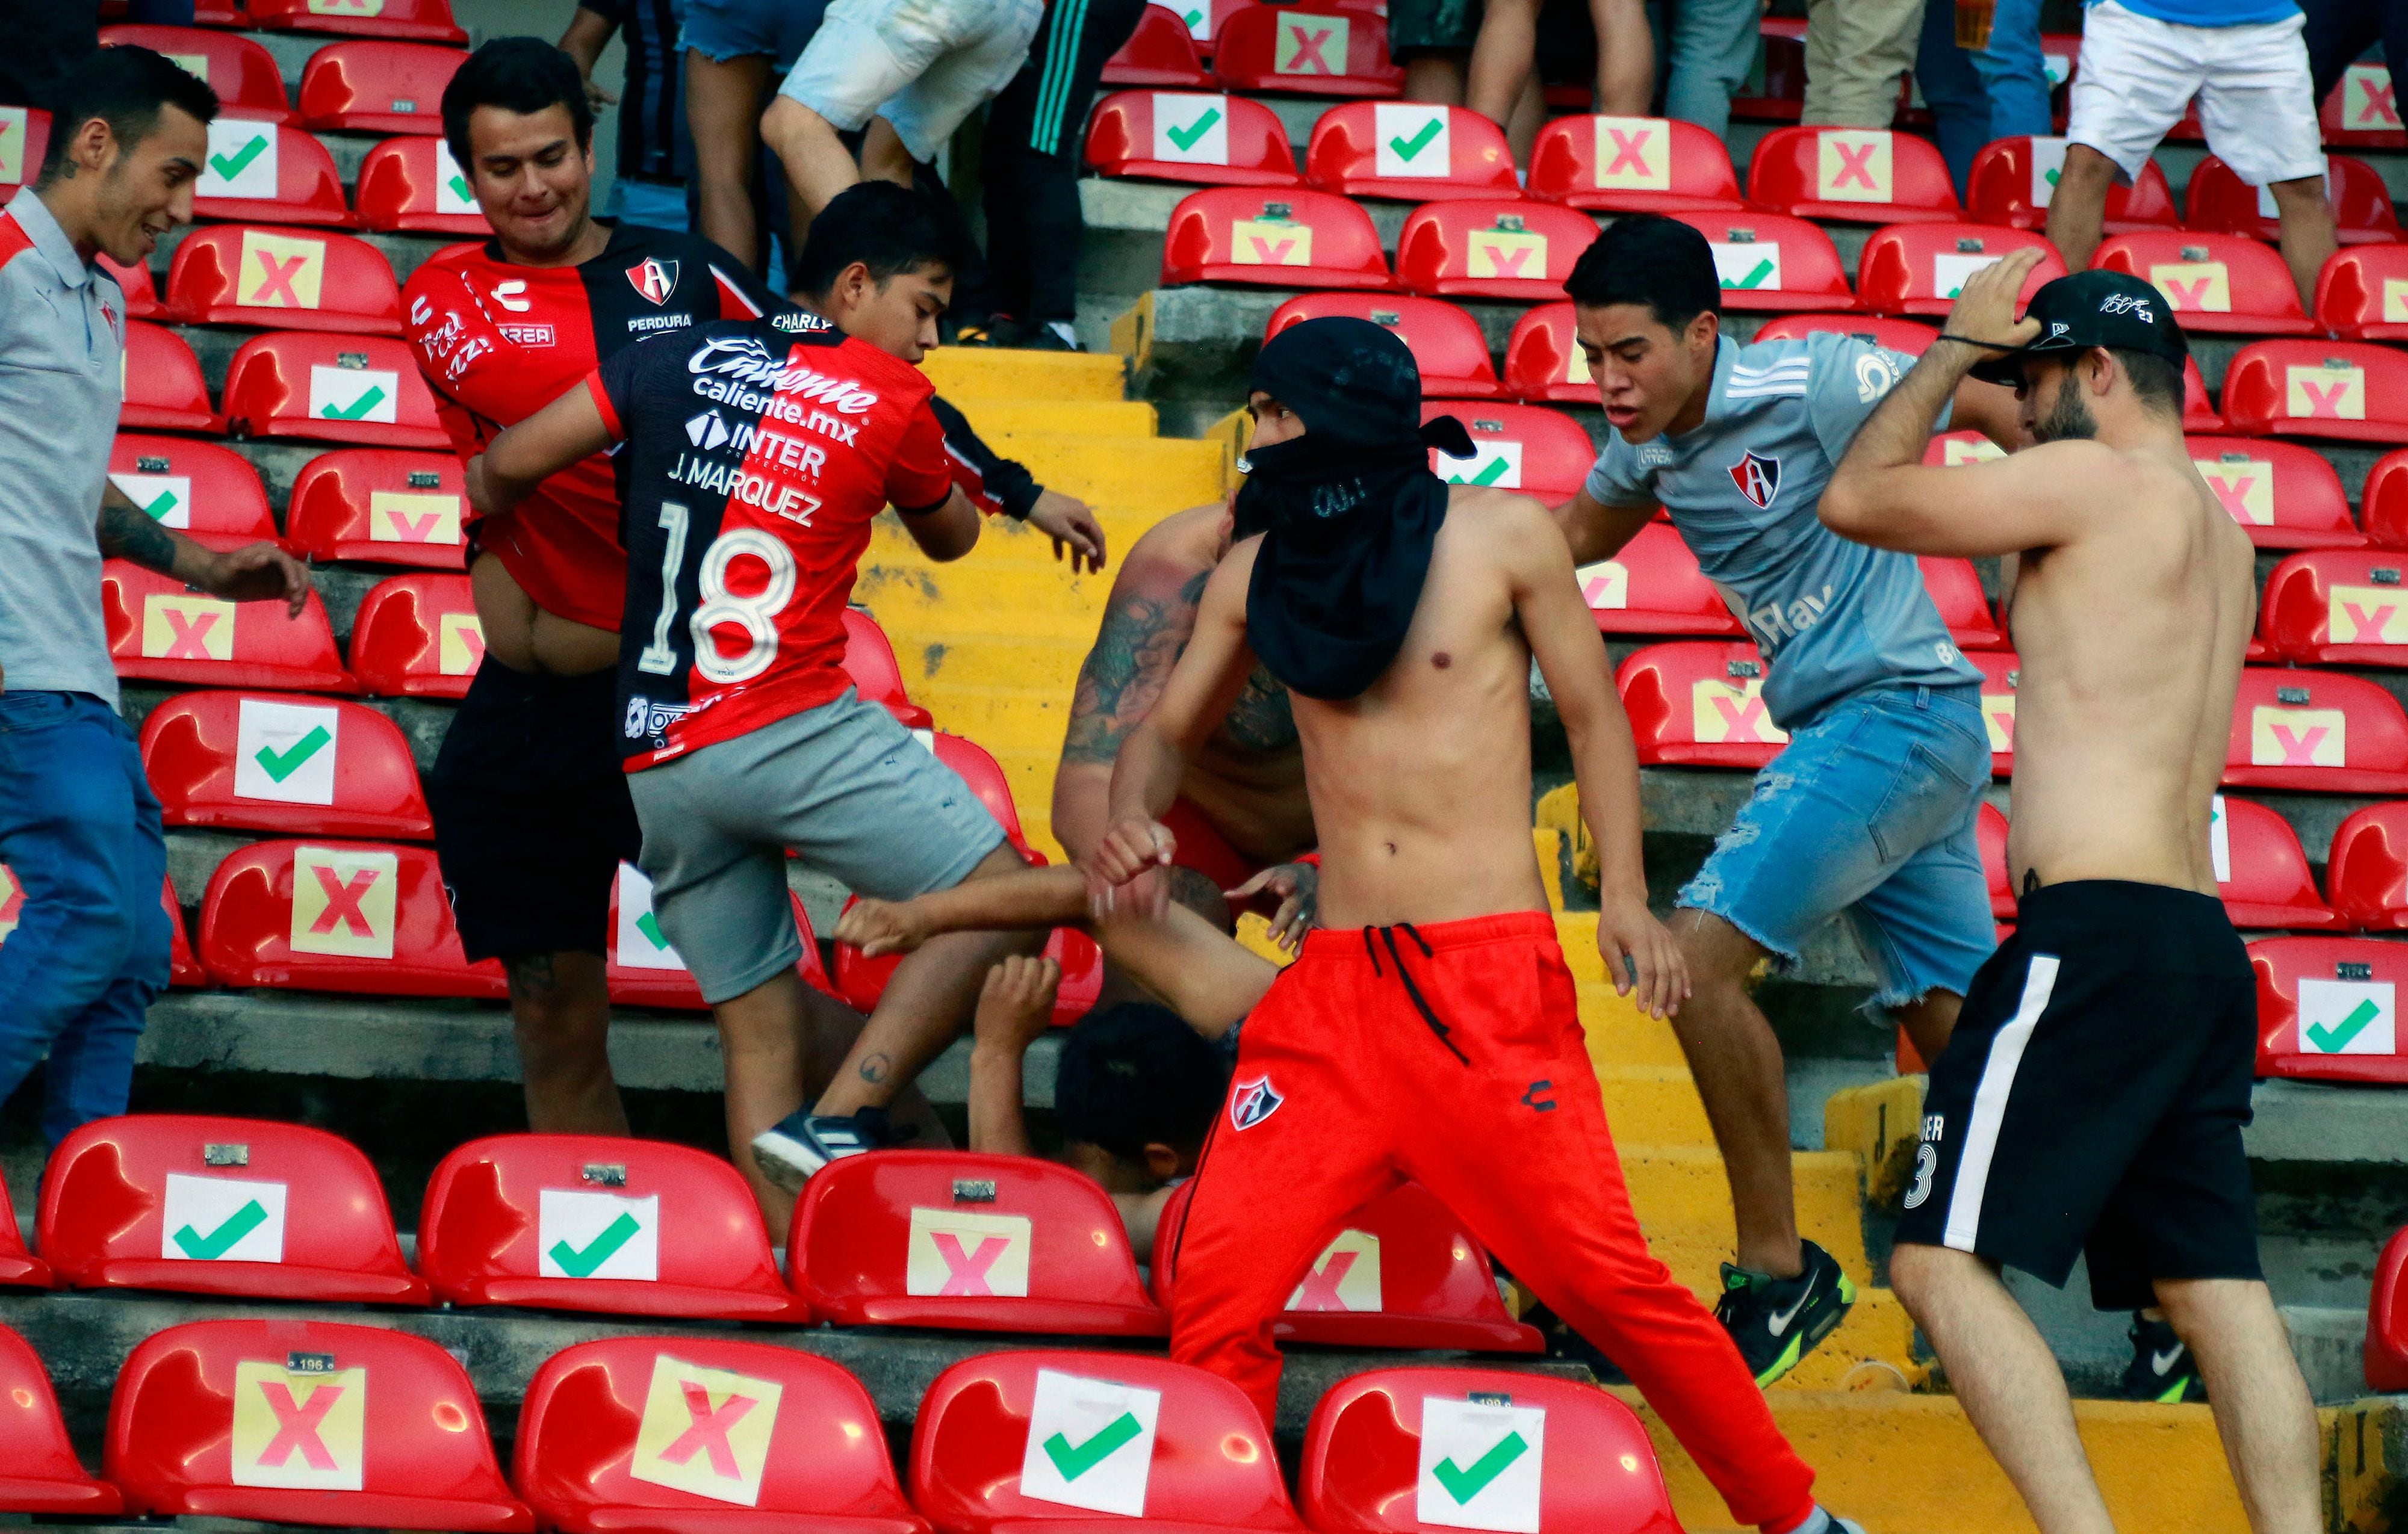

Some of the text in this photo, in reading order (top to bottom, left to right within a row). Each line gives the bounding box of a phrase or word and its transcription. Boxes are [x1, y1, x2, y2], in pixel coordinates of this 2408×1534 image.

[627, 313, 692, 332] PERDURA
[771, 313, 833, 330] CHARLY
[2139, 309, 2153, 324] 23
[687, 337, 878, 414] Caliente
[692, 377, 860, 448] caliente.mx
[730, 422, 826, 478] INTER
[638, 502, 797, 684] 18
[300, 1358, 323, 1371] 196
